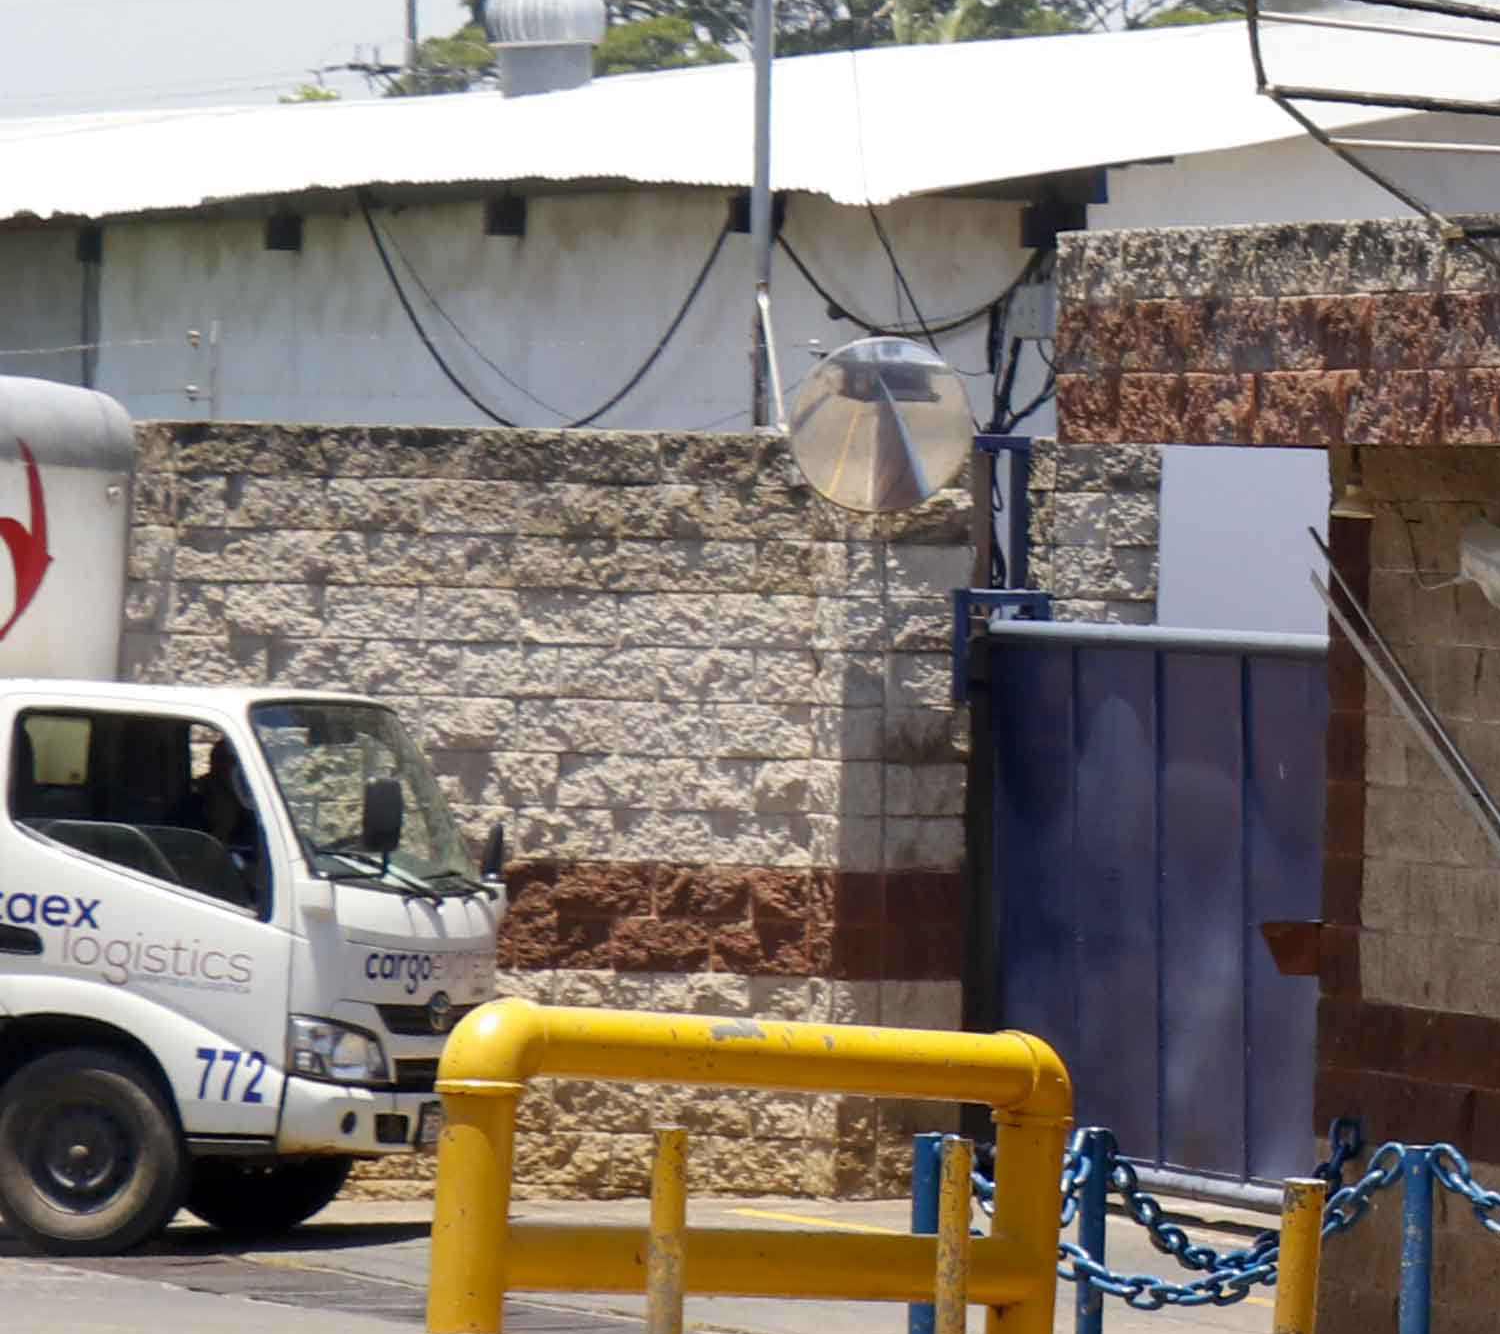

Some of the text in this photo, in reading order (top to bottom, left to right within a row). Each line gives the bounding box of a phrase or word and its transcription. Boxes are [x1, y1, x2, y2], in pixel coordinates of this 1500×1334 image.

[0, 891, 101, 929] aex
[63, 923, 253, 986] logistics
[196, 1047, 267, 1104] 772
